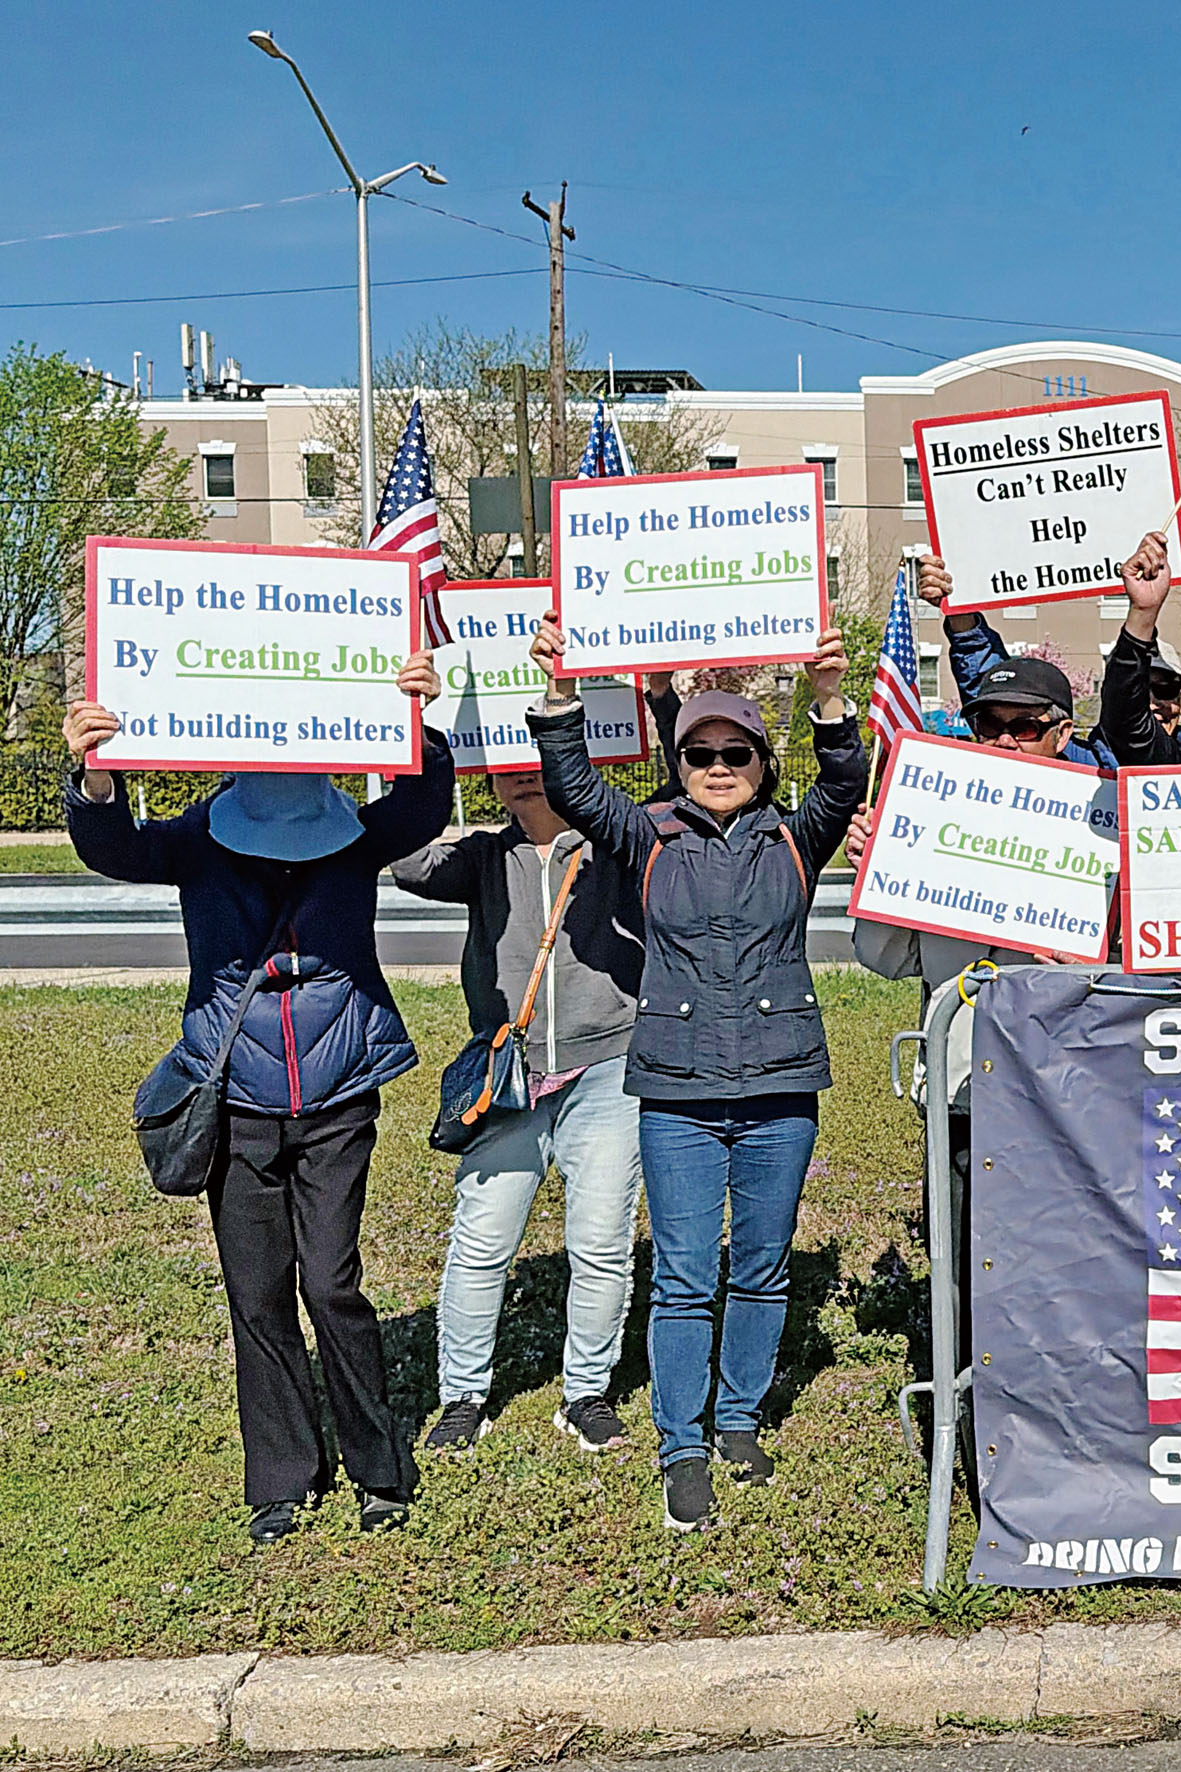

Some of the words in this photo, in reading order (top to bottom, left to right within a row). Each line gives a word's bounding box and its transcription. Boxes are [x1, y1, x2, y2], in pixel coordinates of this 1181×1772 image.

[1043, 375, 1088, 396] 1111
[930, 434, 1050, 468] Homeless
[1058, 421, 1160, 452] Shelters
[977, 473, 1044, 502] Can't
[1053, 464, 1127, 493] Really
[568, 512, 629, 541] Help
[640, 509, 679, 533] the
[688, 501, 810, 530] Homeless
[1030, 516, 1087, 544] Help
[574, 566, 610, 595] By
[624, 557, 742, 585] Creating
[751, 550, 812, 577] Jobs
[991, 570, 1028, 594] the
[1035, 557, 1122, 590] Homele
[107, 577, 184, 615] Help
[197, 582, 245, 609] the
[257, 584, 402, 617] Homeless
[457, 615, 497, 639] the
[567, 625, 610, 649] Not
[619, 619, 716, 646] building
[724, 613, 814, 639] shelters
[114, 639, 158, 676] By
[176, 640, 320, 680] Creating
[331, 645, 402, 675] Jobs
[447, 662, 546, 690] Creatin
[169, 713, 288, 746] building
[299, 716, 405, 742] shelters
[586, 720, 634, 738] lters
[898, 763, 957, 801] Help
[965, 778, 1003, 805] the
[1009, 785, 1119, 830] Homeles
[889, 814, 927, 848] By
[938, 823, 1049, 872] Creating
[1055, 846, 1115, 878] Jobs
[868, 871, 910, 898] Not
[916, 880, 1008, 923] building
[1014, 904, 1100, 937] shelters
